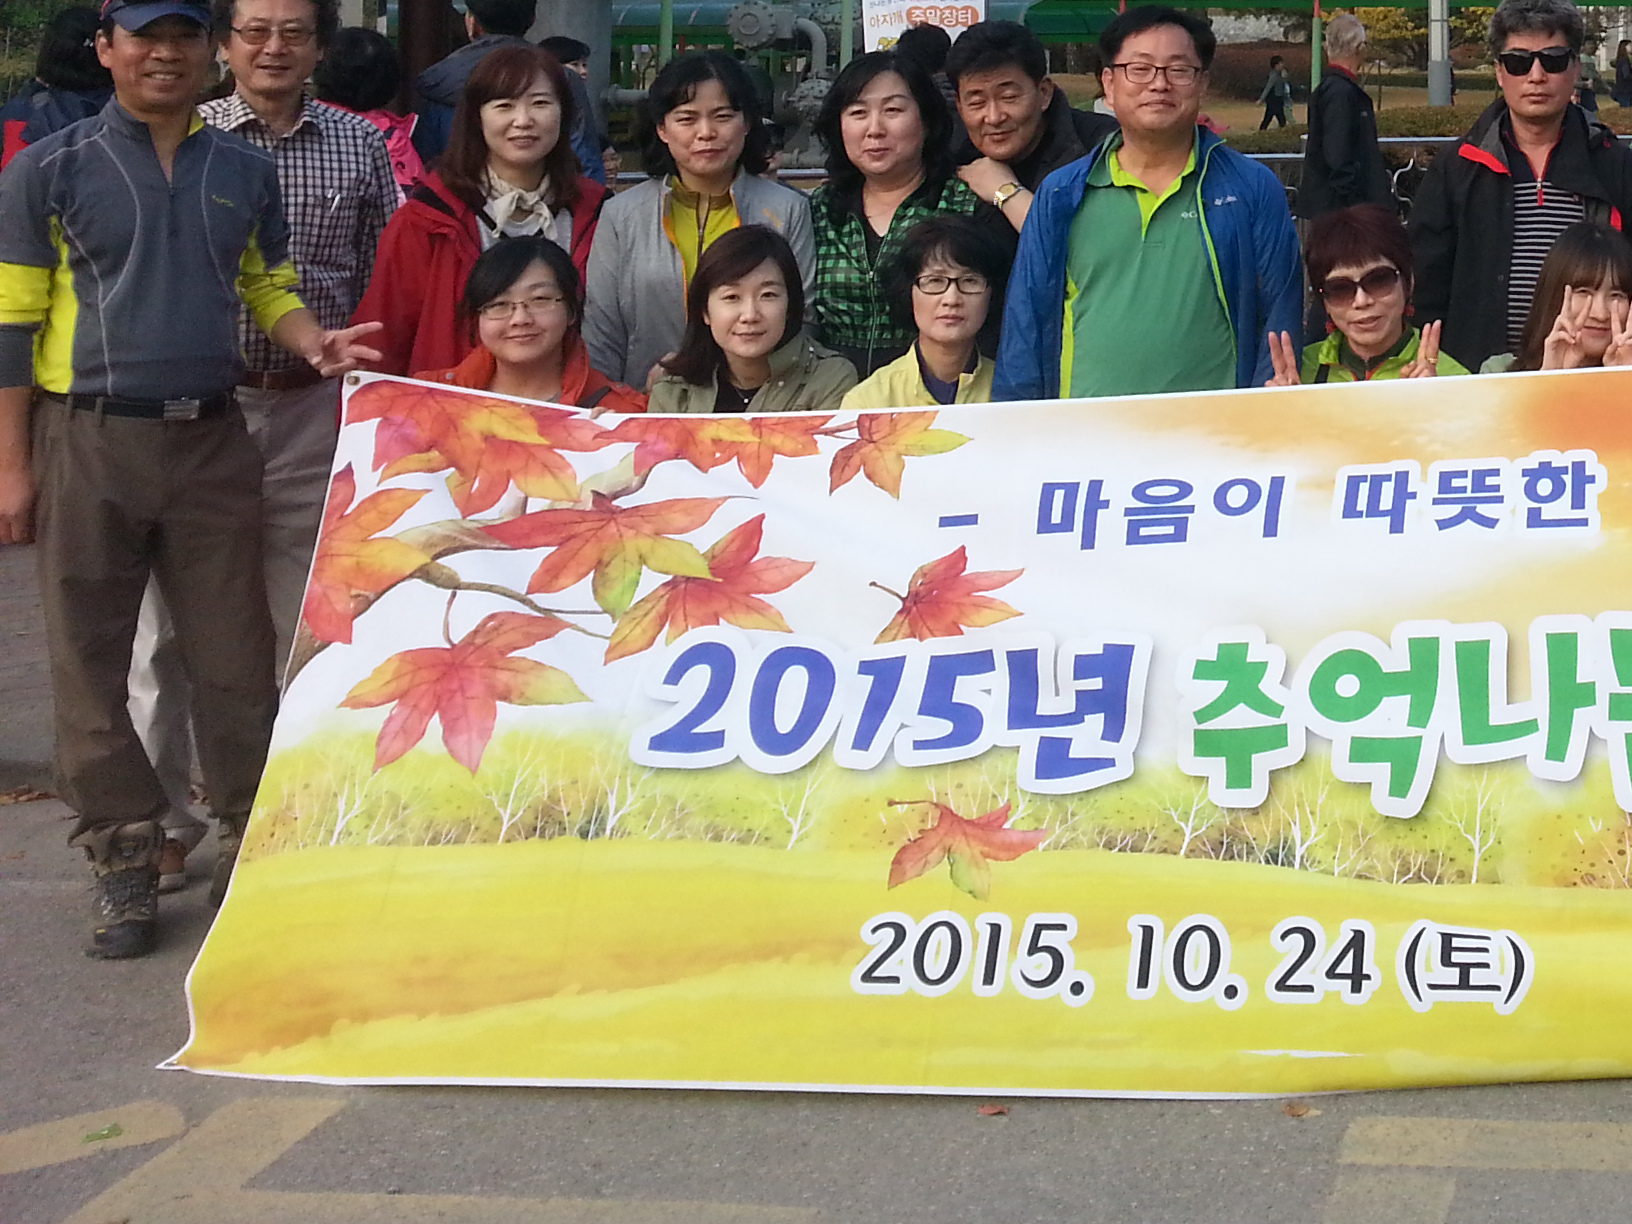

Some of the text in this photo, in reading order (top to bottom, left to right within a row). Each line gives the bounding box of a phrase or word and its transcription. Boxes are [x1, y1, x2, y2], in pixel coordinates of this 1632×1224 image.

[869, 7, 973, 28] 아자개 주말장터
[1035, 475, 1286, 551] 마음이
[1341, 460, 1597, 534] 따뜻한
[648, 640, 1135, 780] 2015년
[859, 920, 1526, 1005] 2015. 10. 24 (토)
